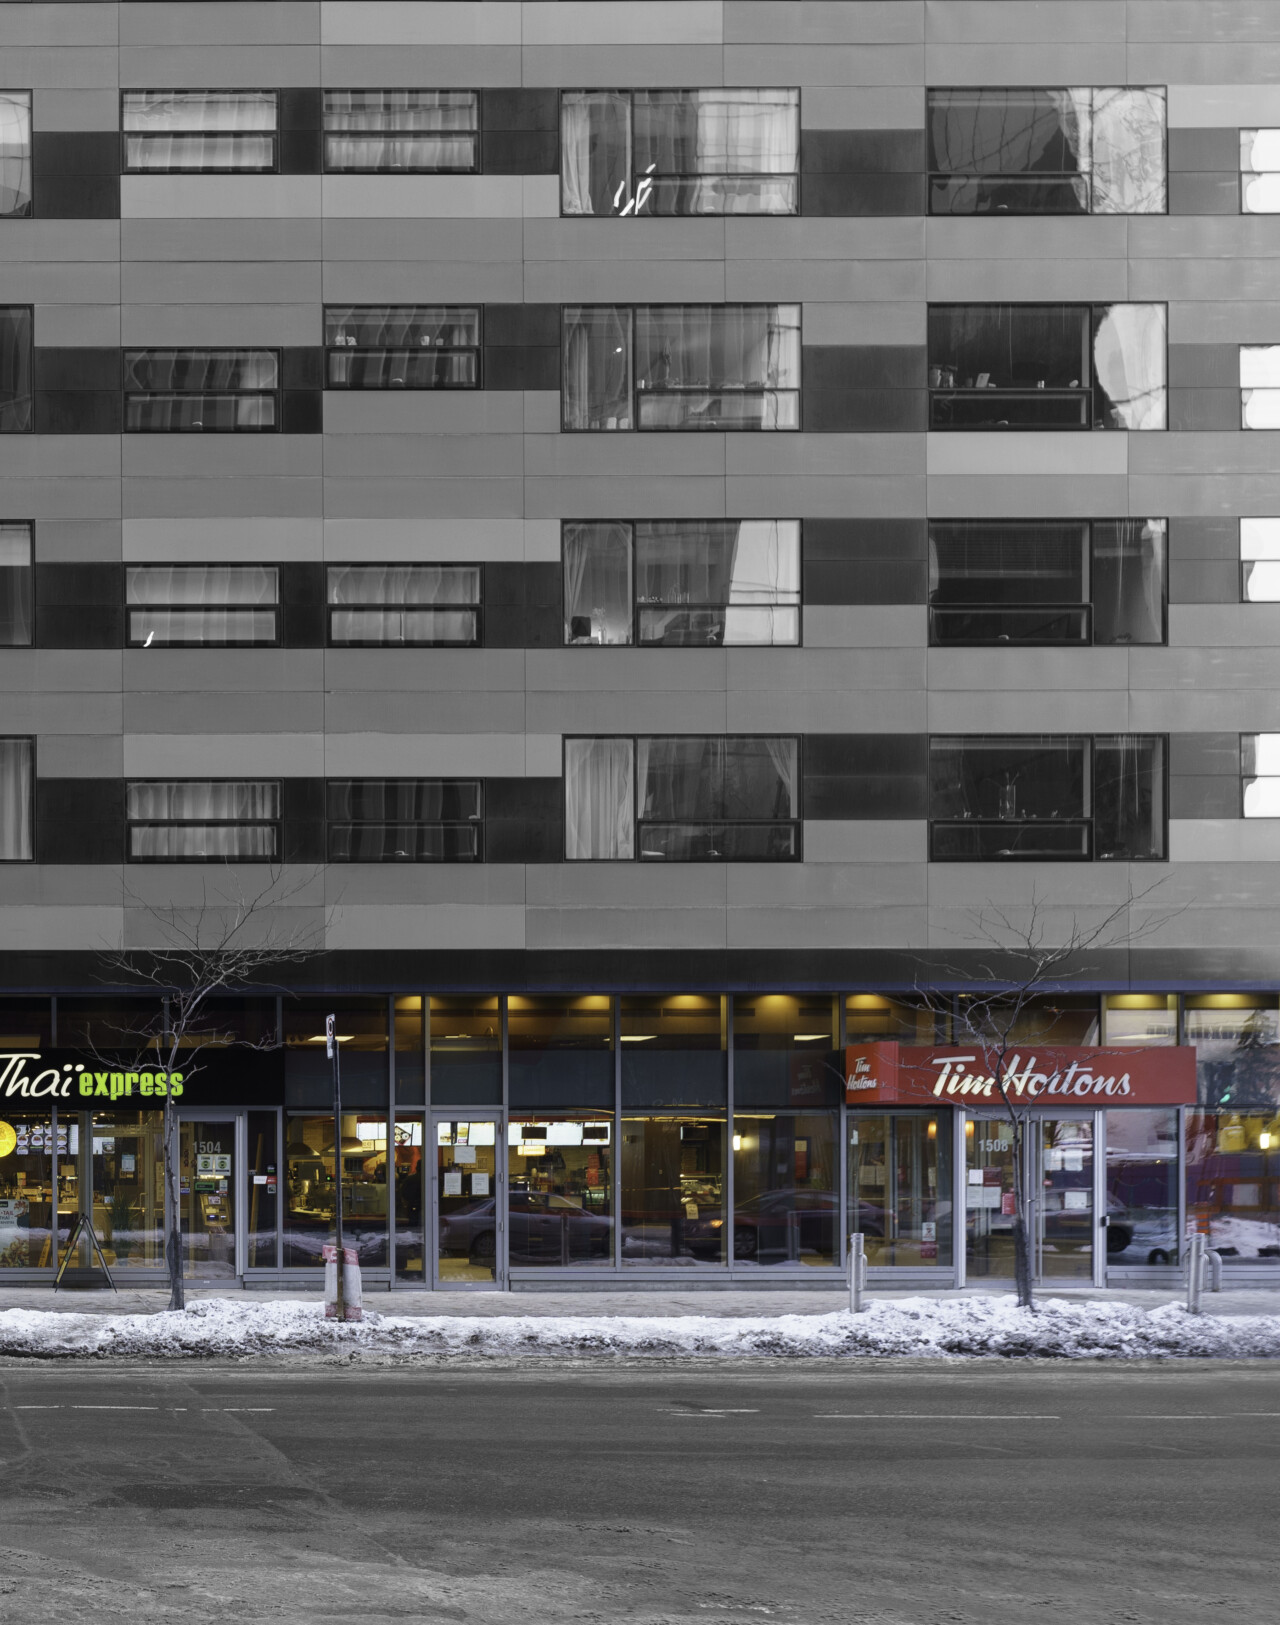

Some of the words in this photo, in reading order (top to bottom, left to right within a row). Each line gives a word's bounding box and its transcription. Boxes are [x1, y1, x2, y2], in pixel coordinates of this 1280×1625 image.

[854, 1056, 871, 1073] Tim
[847, 1073, 877, 1090] Hortons
[931, 1055, 996, 1097] Tim
[999, 1053, 1130, 1097] Hortons
[79, 1072, 184, 1101] express
[193, 1141, 221, 1154] 1504
[978, 1139, 1009, 1152] 1508
